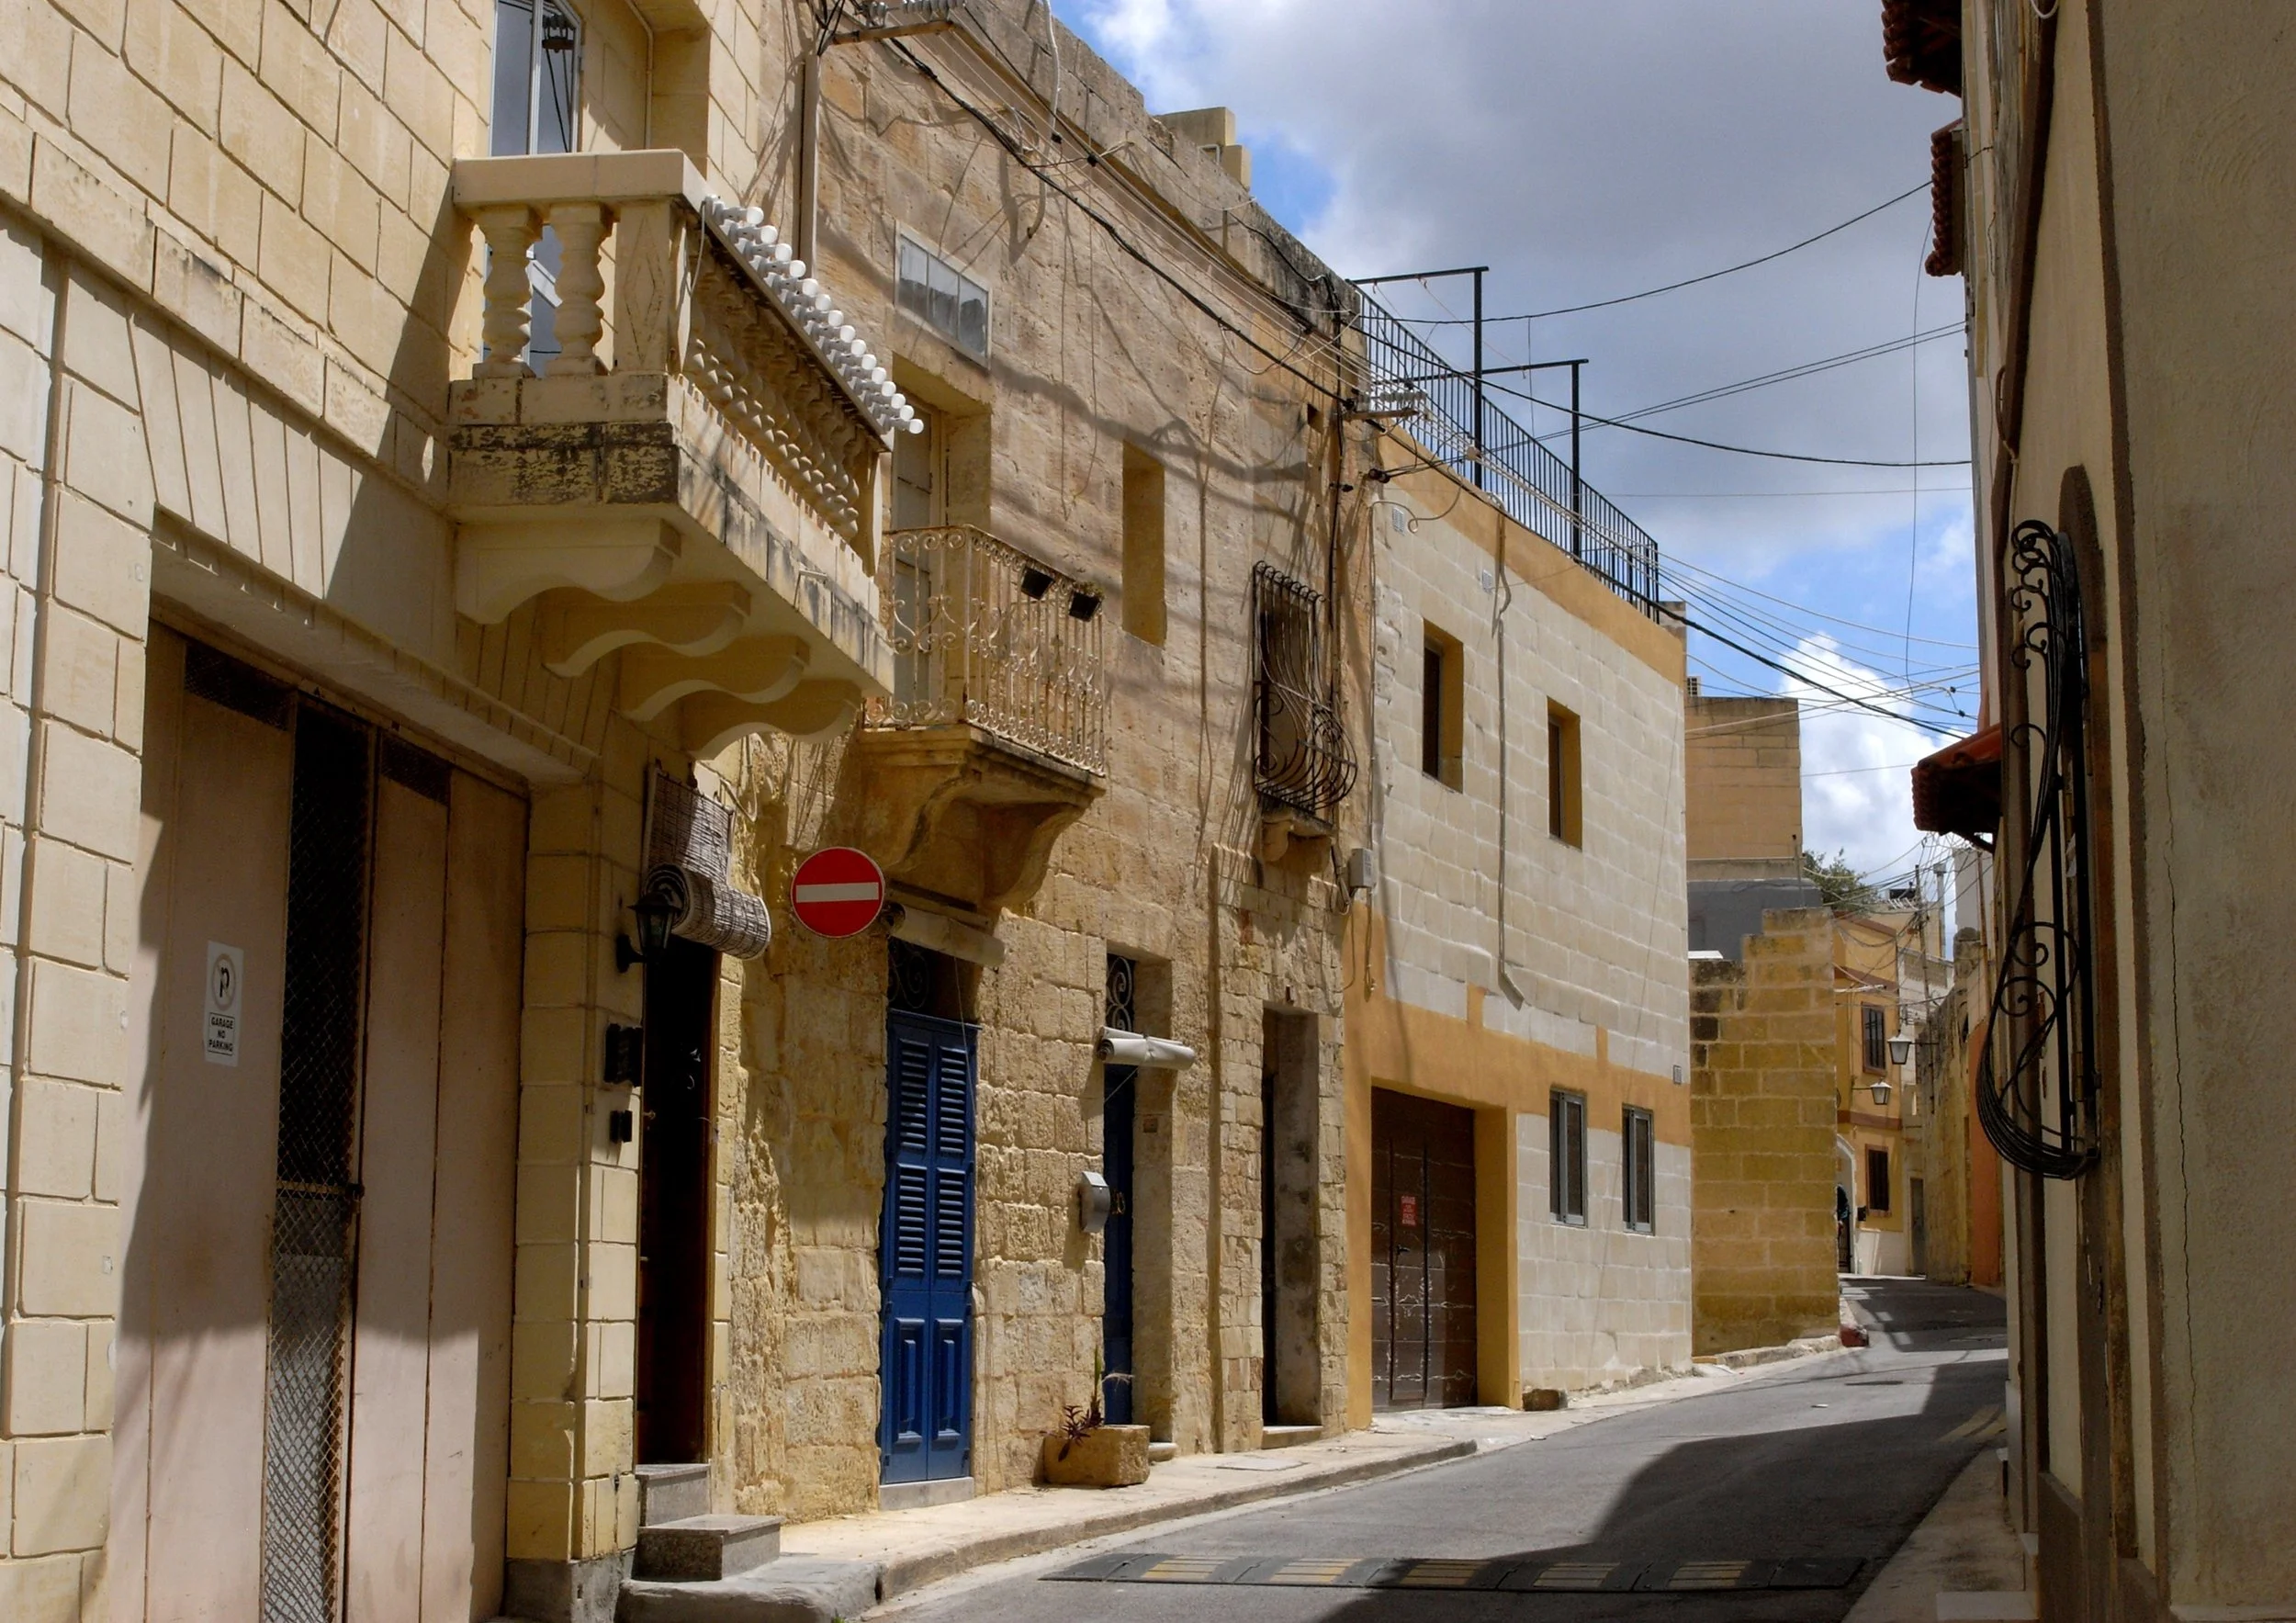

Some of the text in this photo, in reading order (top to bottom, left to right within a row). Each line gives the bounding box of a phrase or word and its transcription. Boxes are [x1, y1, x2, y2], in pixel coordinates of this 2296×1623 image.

[211, 1016, 233, 1030] GARAGE
[217, 1030, 226, 1039] NO
[208, 1039, 233, 1052] PARKING
